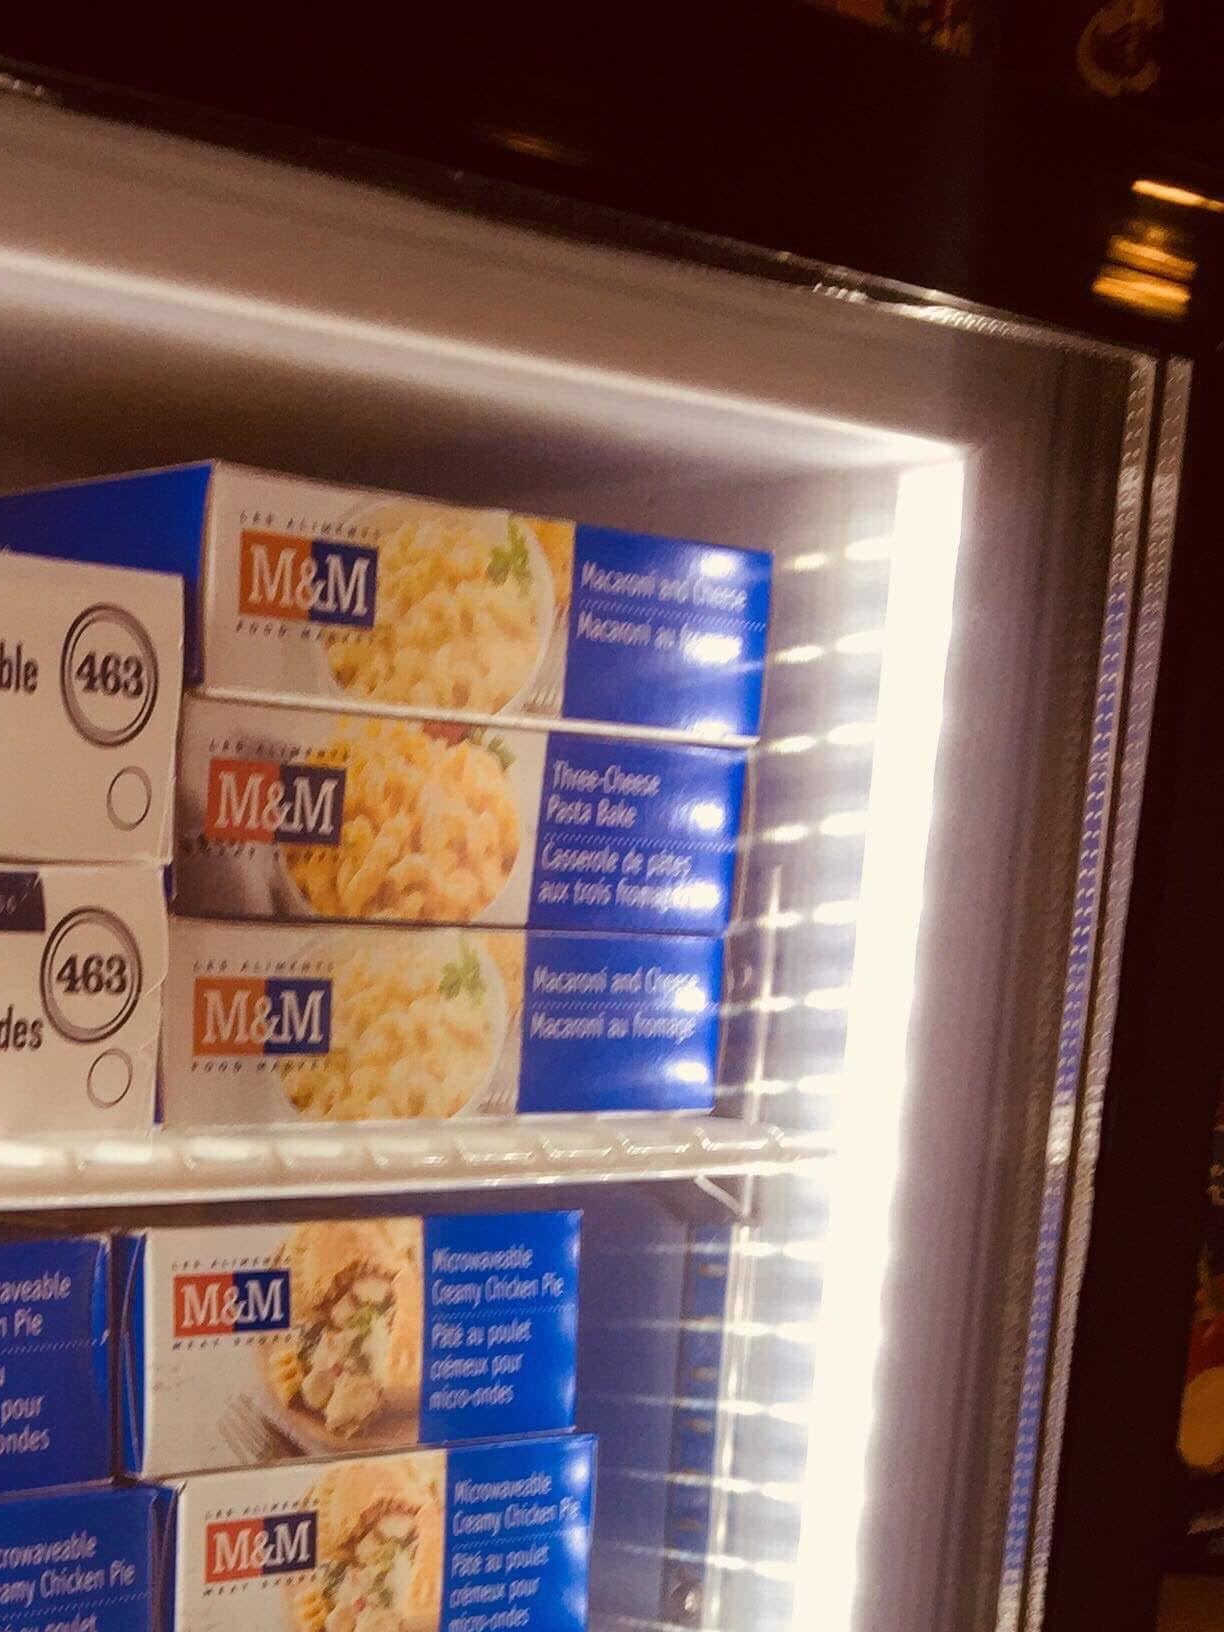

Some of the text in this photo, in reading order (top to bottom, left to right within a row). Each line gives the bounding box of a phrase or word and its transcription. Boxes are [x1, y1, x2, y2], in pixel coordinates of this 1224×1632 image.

[248, 543, 371, 616] M&M
[76, 650, 145, 700] 463
[552, 759, 662, 797] Three-Cheese
[214, 770, 339, 835] M&M
[546, 793, 638, 829] Pasta Bake
[541, 839, 620, 873] Casserole
[538, 879, 570, 905] aux
[56, 953, 127, 995] 463
[532, 965, 608, 994] Macaroni
[610, 965, 644, 994] and
[201, 989, 326, 1044] M&M
[529, 1011, 606, 1040] Macaroni
[431, 1243, 534, 1274] Microwaveable
[180, 1278, 285, 1329] M&M
[431, 1271, 565, 1309] Creamy Chicken Pie
[13, 1306, 44, 1338] Pie
[465, 1325, 486, 1346] au
[487, 1316, 533, 1350] poulet
[491, 1353, 524, 1379] pour
[0, 1395, 46, 1428] pour
[428, 1378, 515, 1411] micro-ondes
[454, 1470, 553, 1505] Microwaveable
[452, 1510, 503, 1537] Creamy
[504, 1502, 558, 1530] Chicken
[212, 1519, 313, 1575] M&M
[484, 1553, 504, 1574] au
[505, 1542, 550, 1577] poulet
[39, 1563, 105, 1599] Chicken
[108, 1558, 136, 1588] Pie
[508, 1577, 542, 1605] pour
